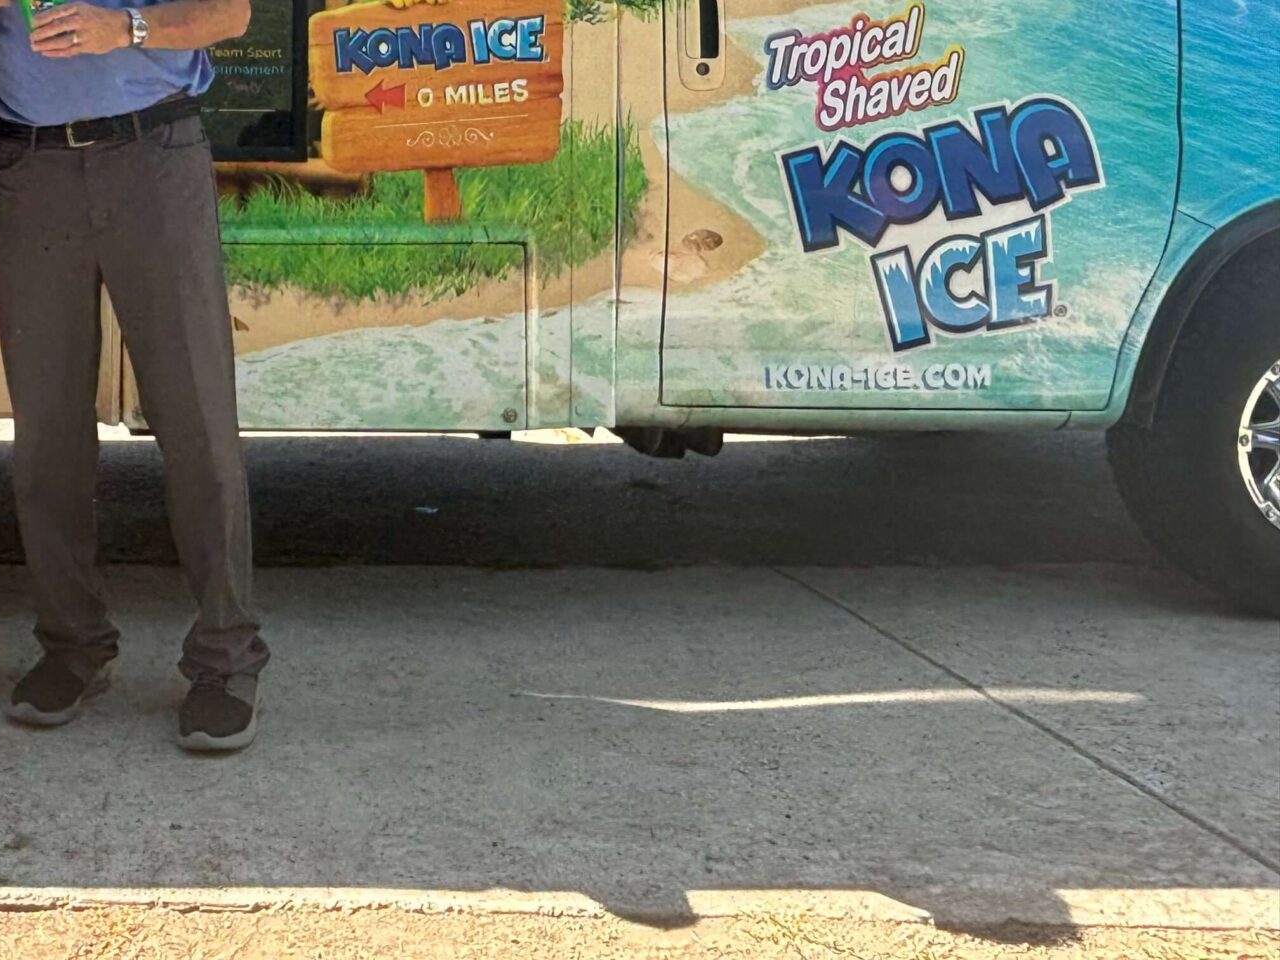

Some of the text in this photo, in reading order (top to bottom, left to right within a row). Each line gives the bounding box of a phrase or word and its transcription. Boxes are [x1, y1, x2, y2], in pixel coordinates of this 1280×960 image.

[212, 64, 285, 76] ournament
[333, 15, 545, 75] KONA ICE
[768, 3, 922, 85] Tropical
[444, 78, 529, 105] MILES
[818, 52, 959, 129] Shaved
[780, 96, 1102, 253] KONA
[870, 214, 1053, 352] ICE
[765, 363, 992, 390] KONA-ICE.COM
